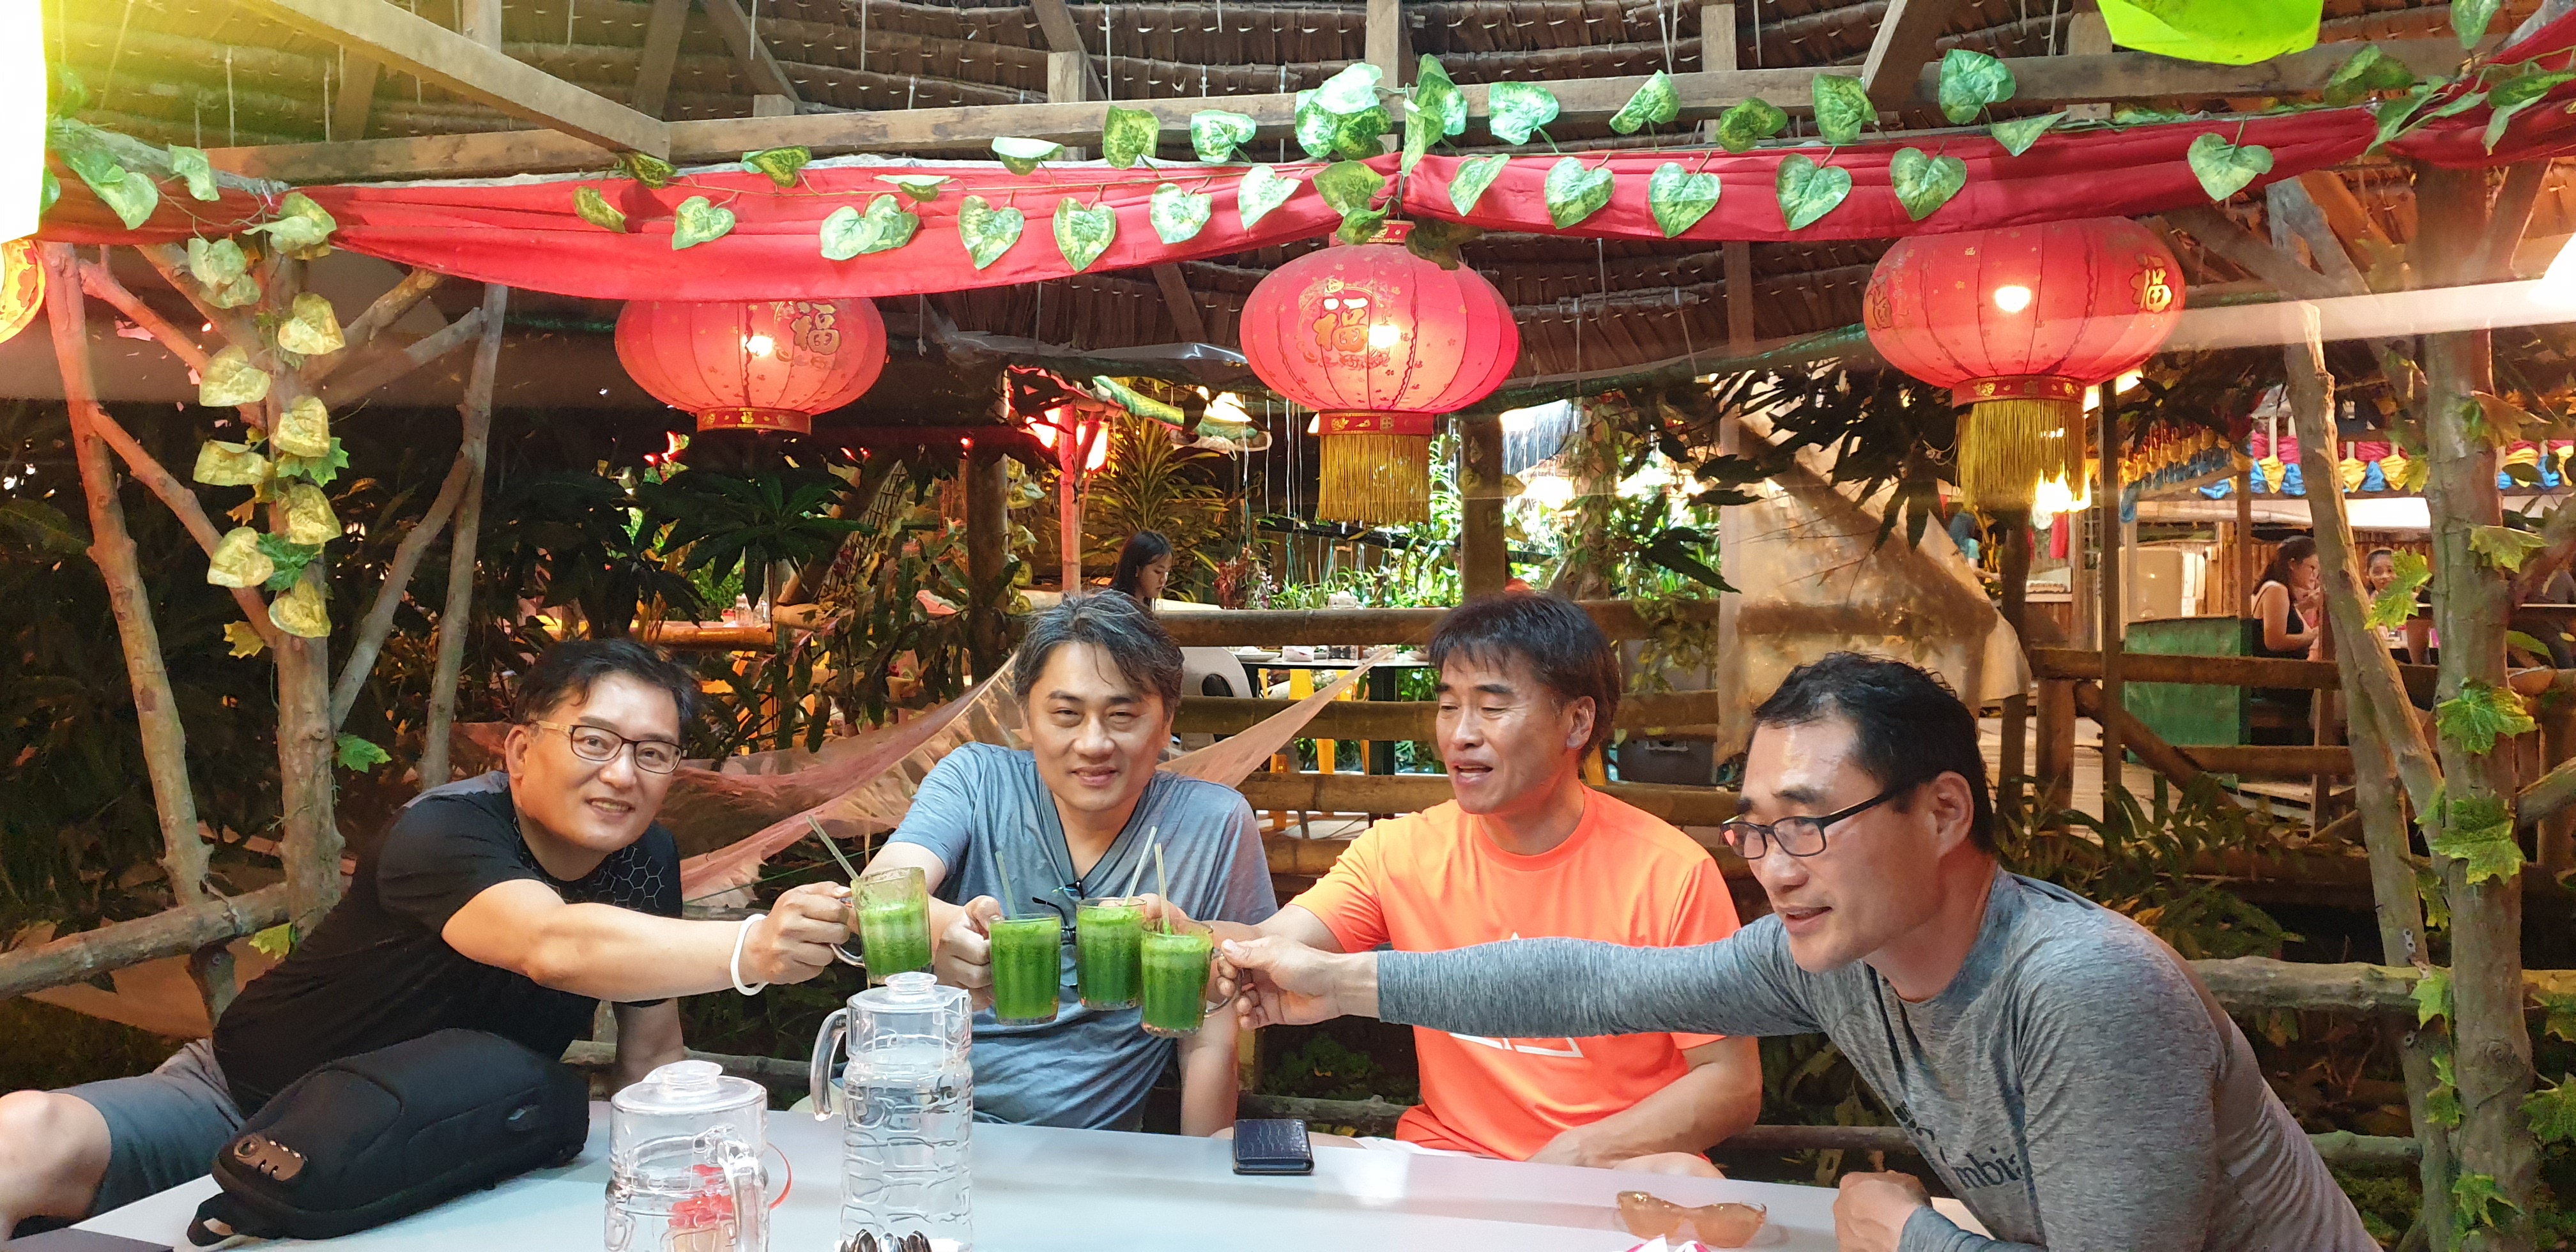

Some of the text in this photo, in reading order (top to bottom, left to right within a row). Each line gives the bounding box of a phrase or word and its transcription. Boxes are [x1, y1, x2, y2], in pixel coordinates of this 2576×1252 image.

[2129, 253, 2172, 314] 福
[790, 301, 841, 355] 福
[1312, 297, 1370, 352] 福
